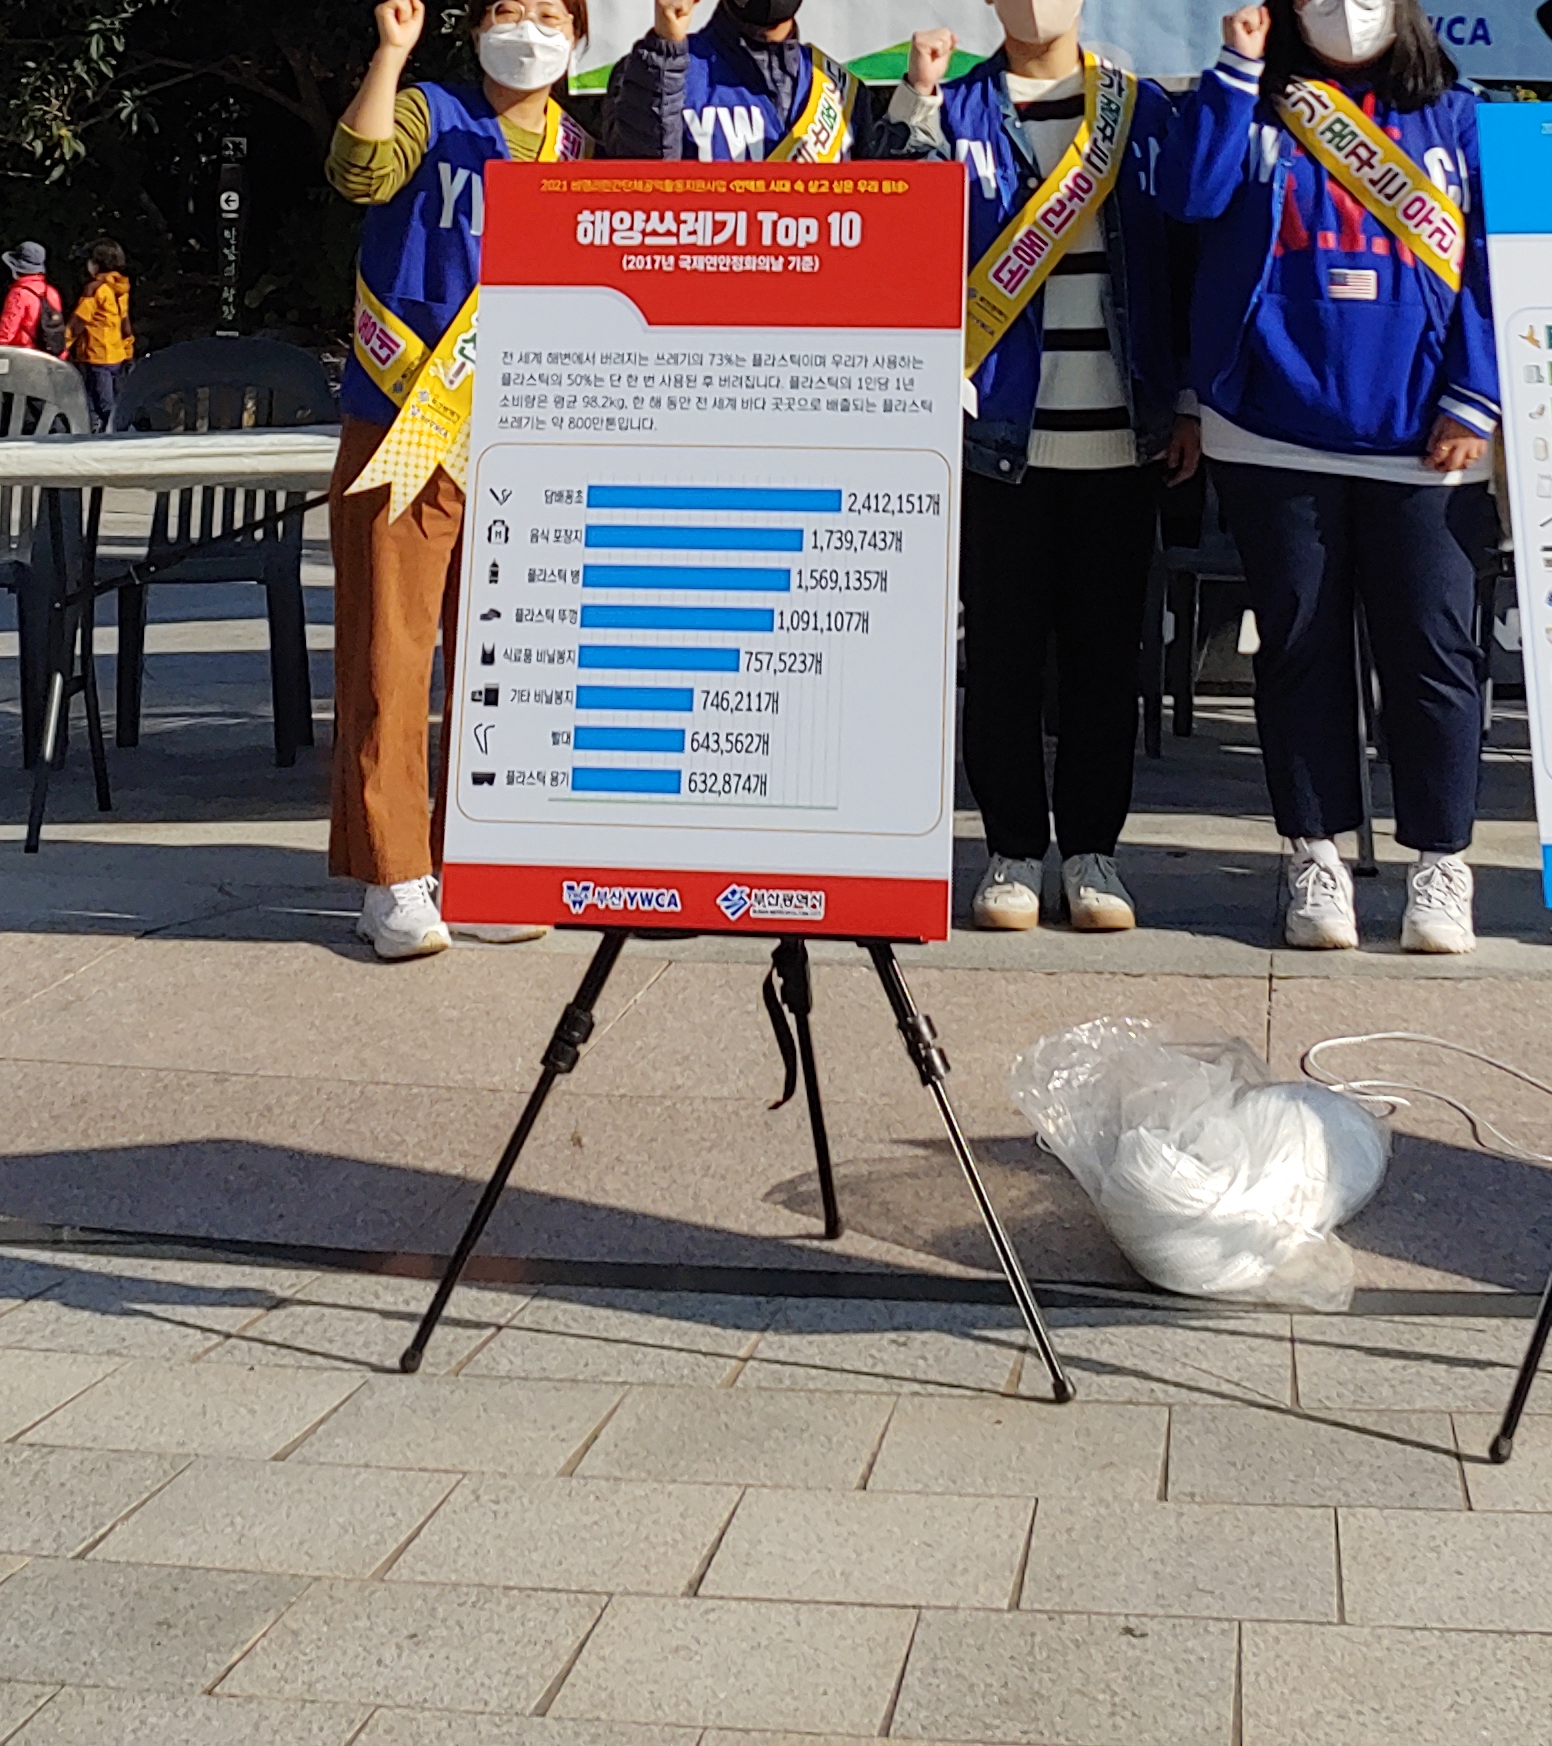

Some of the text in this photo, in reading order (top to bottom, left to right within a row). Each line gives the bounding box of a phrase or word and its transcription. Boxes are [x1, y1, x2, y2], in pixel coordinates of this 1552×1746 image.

[576, 210, 862, 248] 해양쓰레기 Top 10
[621, 254, 675, 272] (2017년
[788, 254, 820, 272] 기준)
[847, 491, 941, 516] 2,412,151개
[810, 529, 903, 553] 1,739,743개
[796, 568, 888, 593] 1,569,135개
[777, 608, 870, 635] 1,091,107개
[744, 650, 823, 675] 757,523개
[700, 689, 780, 715] 746,211개
[689, 730, 770, 757] 643,562개
[687, 772, 768, 798] 632,874개
[627, 890, 679, 909] YWCA
